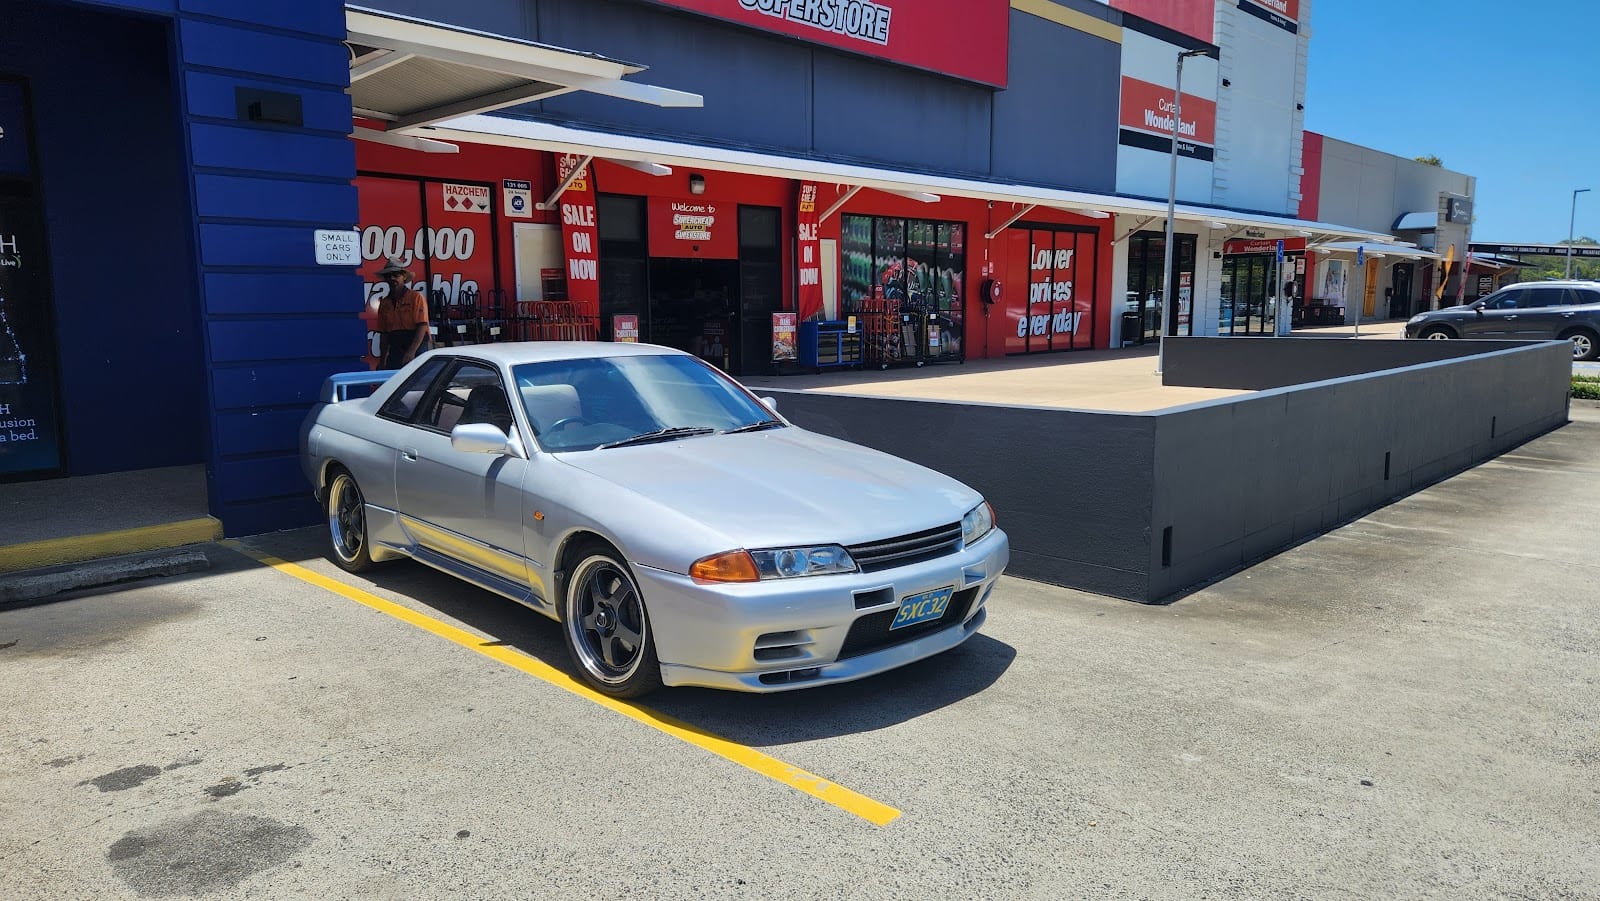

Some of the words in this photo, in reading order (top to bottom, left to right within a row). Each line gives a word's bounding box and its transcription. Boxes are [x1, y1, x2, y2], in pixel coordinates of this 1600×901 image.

[1144, 108, 1196, 136] Wondeland
[446, 185, 488, 197] HAZCHEM
[562, 203, 595, 227] SALE
[671, 202, 705, 213] Welcome
[707, 204, 716, 213] to
[321, 233, 354, 243] SMALL
[572, 231, 591, 254] ON
[325, 243, 351, 252] CARS
[1243, 244, 1278, 253] Wonderla
[326, 253, 352, 261] ONLY
[1030, 243, 1074, 271] Lower
[569, 258, 597, 281] NOW
[1029, 276, 1073, 306] prices
[1017, 307, 1082, 340] everyday
[0, 434, 7, 442] a
[10, 428, 39, 442] bed.
